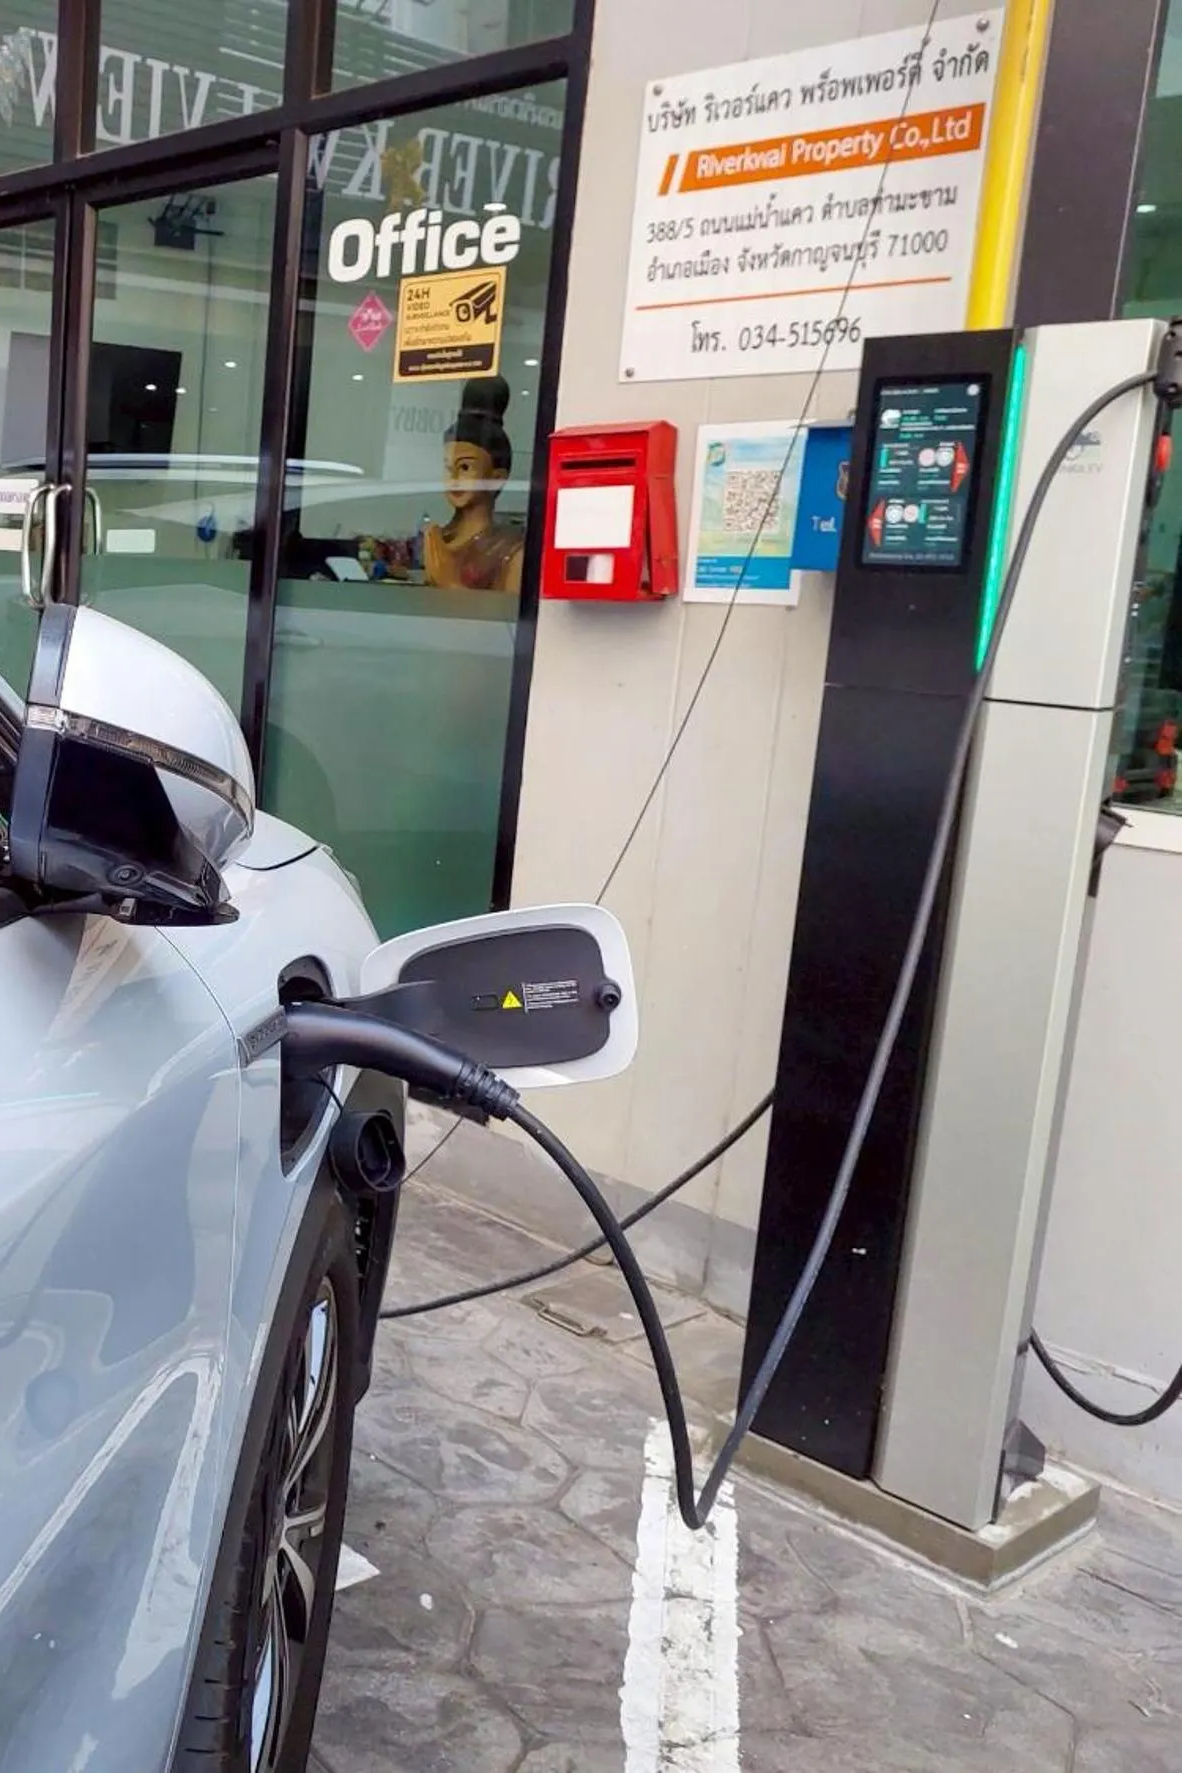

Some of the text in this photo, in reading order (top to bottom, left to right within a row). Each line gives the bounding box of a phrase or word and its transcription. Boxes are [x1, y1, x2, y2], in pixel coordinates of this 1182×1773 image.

[647, 98, 697, 133] บริษัท
[704, 82, 793, 123] ริเวอร์แคว
[932, 42, 990, 82] จำกัด
[791, 130, 884, 165] Property
[328, 208, 522, 283] Office
[646, 217, 694, 244] 388/5
[887, 229, 949, 258] 71000
[690, 317, 862, 353] โทร. 034-515696
